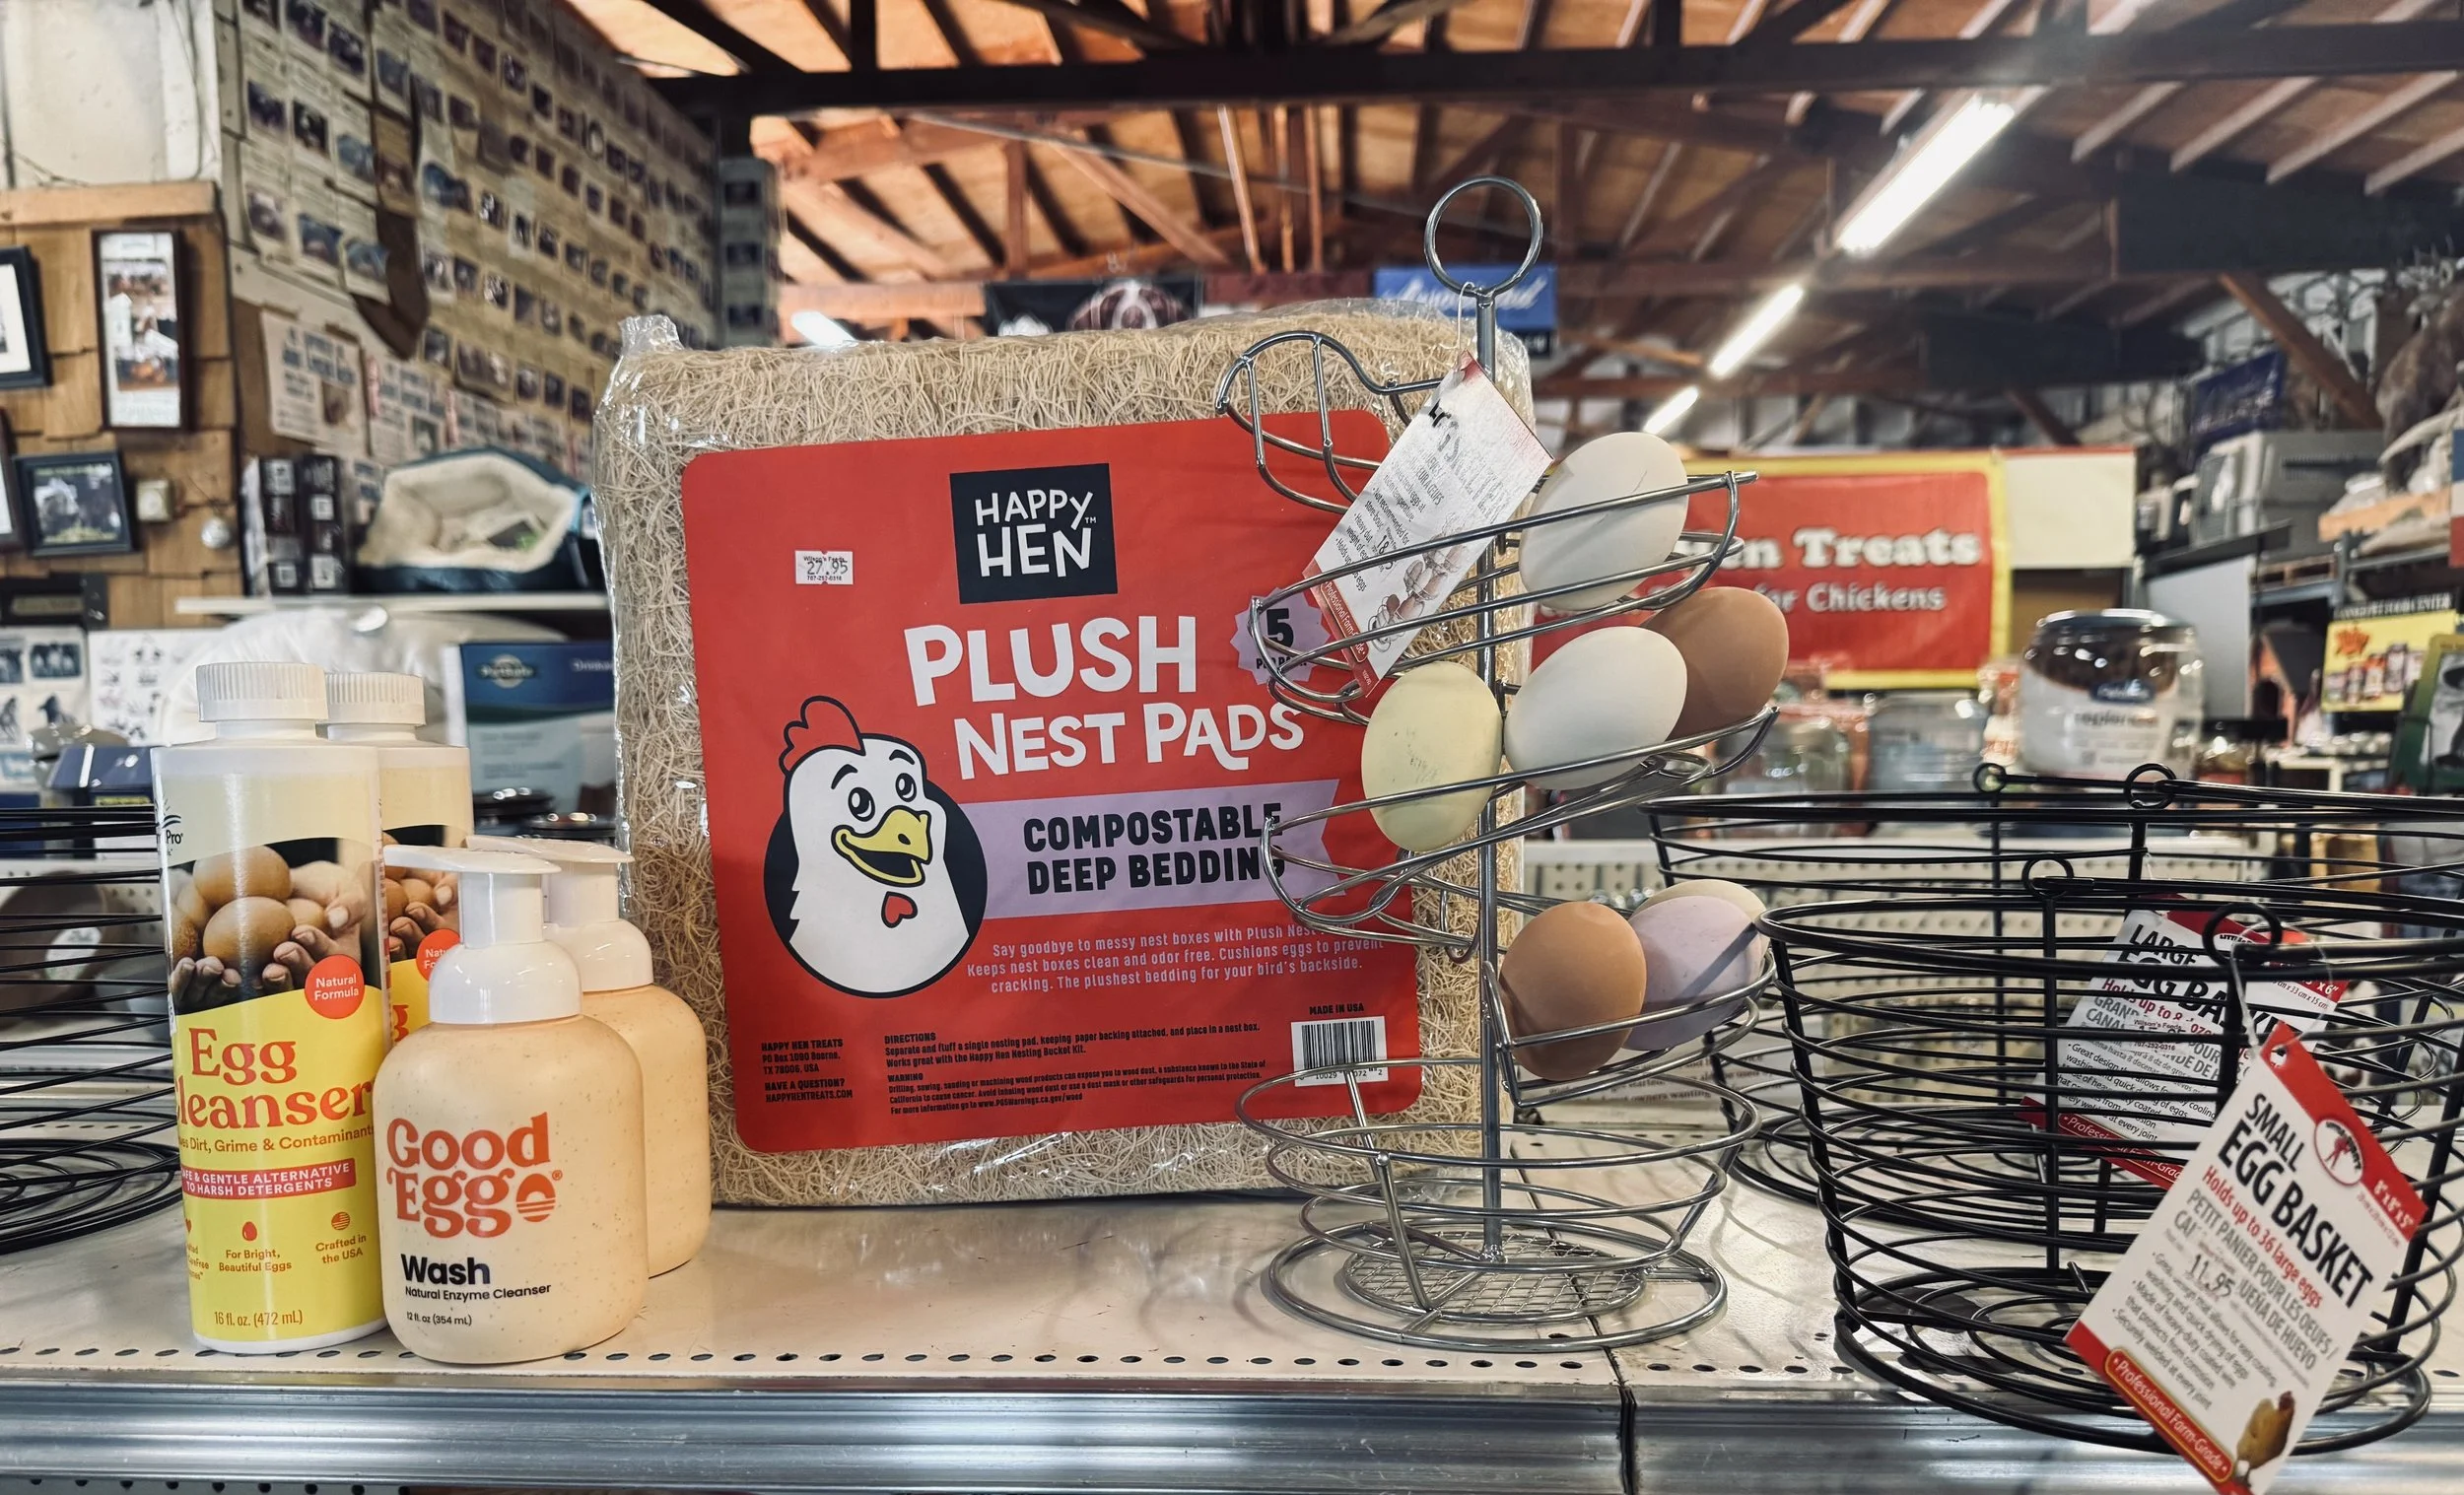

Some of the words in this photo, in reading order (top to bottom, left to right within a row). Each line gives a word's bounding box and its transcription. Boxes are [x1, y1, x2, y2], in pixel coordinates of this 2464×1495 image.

[975, 489, 1093, 530] HAPPY
[1351, 512, 1368, 535] Heavy
[1377, 497, 1405, 538] recommended
[1401, 532, 1410, 547] for
[977, 523, 1091, 578] HEN
[1792, 525, 1983, 569] Treats
[807, 560, 849, 576] 27.95
[1323, 580, 1348, 620] Professional
[1806, 581, 1947, 612] Chickens
[1266, 608, 1294, 648] 5
[904, 616, 1197, 707] PLUSH
[954, 712, 1125, 780] NEST
[1143, 702, 1305, 771] PADS
[1027, 853, 1117, 895] DEEP
[993, 944, 1015, 958] Say
[1021, 939, 1073, 958] goodbye
[1078, 939, 1091, 951] to
[1096, 936, 1135, 952] messy
[1140, 933, 1168, 947] nest
[1173, 932, 1210, 945] boxes
[1213, 928, 1242, 943] with
[1248, 925, 1283, 941] Plush
[968, 963, 1006, 978] Keeps
[1010, 960, 1038, 974] nest
[1043, 957, 1080, 972] boxes
[1084, 954, 1120, 970] clean
[1124, 953, 1147, 968] and
[1151, 951, 1180, 965] odor
[1184, 948, 1215, 964] free.
[1219, 944, 1278, 961] Cushions
[1282, 943, 1313, 958] eggs
[1317, 940, 1330, 953] to
[992, 978, 1054, 993] cracking.
[1057, 976, 1080, 989] The
[1084, 971, 1141, 989] plushest
[1145, 967, 1197, 984] bedding
[1200, 966, 1219, 980] for
[1224, 965, 1253, 981] your
[1257, 961, 1296, 976] bird's
[1300, 957, 1363, 973] backside.
[314, 986, 360, 1001] Formula
[315, 974, 357, 988] Natural
[1309, 1005, 1334, 1015] MADE
[1335, 1004, 1345, 1014] IN
[1346, 1002, 1365, 1013] USA
[761, 1042, 790, 1052] HAPPY
[791, 1041, 809, 1051] HEN
[811, 1039, 844, 1049] TREATS
[884, 1032, 936, 1045] DIRECTIONS
[885, 1045, 921, 1056] Separate
[922, 1044, 936, 1053] and
[938, 1041, 956, 1053] fluff
[964, 1040, 990, 1052] single
[991, 1038, 1020, 1050] nesting
[1040, 1034, 1071, 1046] keeping
[1075, 1032, 1097, 1044] paper
[1099, 1030, 1130, 1041] backing
[1170, 1027, 1185, 1037] and
[1186, 1026, 1207, 1037] place
[1208, 1024, 1217, 1034] in
[1224, 1023, 1243, 1033] nest
[1243, 1022, 1261, 1032] box.
[188, 1027, 298, 1086] Egg
[762, 1053, 773, 1063] PO
[774, 1053, 788, 1063] Box
[789, 1052, 810, 1062] 1090
[763, 1065, 774, 1075] TX
[804, 1063, 820, 1073] USA
[2070, 1042, 2094, 1059] Great
[2090, 1052, 2120, 1073] design
[765, 1082, 787, 1091] HAVE
[789, 1081, 796, 1090] A
[797, 1078, 846, 1090] QUESTION?
[766, 1089, 854, 1103] HAPPYHENTREATS.COM
[177, 1075, 373, 1129] leanser
[190, 1137, 212, 1154] Dirt,
[214, 1138, 258, 1153] Grime
[262, 1139, 275, 1151] &
[386, 1111, 551, 1171] Good
[2115, 1117, 2140, 1135] every
[2137, 1127, 2158, 1143] joint
[2242, 1089, 2310, 1174] SMALL
[186, 1182, 196, 1192] TO
[197, 1184, 234, 1196] HARSH
[238, 1178, 333, 1196] DETERGENTS
[194, 1172, 200, 1183] &
[202, 1173, 248, 1185] GENTLE
[252, 1162, 350, 1184] ALTERNATIVE
[386, 1167, 515, 1239] Egg
[2216, 1118, 2287, 1208] EGG
[2268, 1179, 2376, 1312] BASKET
[226, 1250, 241, 1259] For
[243, 1249, 281, 1260] Bright,
[315, 1234, 356, 1253] Crafted
[358, 1234, 367, 1245] in
[322, 1254, 340, 1264] the
[342, 1247, 364, 1260] USA
[2201, 1164, 2237, 1209] Holds
[2227, 1199, 2250, 1229] up
[2246, 1216, 2263, 1240] to
[2257, 1228, 2277, 1255] 36
[2268, 1243, 2302, 1287] large
[2293, 1275, 2323, 1314] eggs
[219, 1261, 262, 1273] Beautiful
[264, 1261, 293, 1273] Eggs
[400, 1253, 491, 1286] Wash
[2185, 1185, 2224, 1232] PETIT
[2215, 1218, 2259, 1273] PANIER
[2252, 1260, 2289, 1307] POUR
[2280, 1291, 2304, 1324] LES
[2295, 1309, 2333, 1356] OEUFS
[2187, 1247, 2235, 1308] 11.95
[405, 1286, 442, 1301] Natural
[443, 1289, 491, 1304] Enzyme
[493, 1283, 552, 1300] Cleanser
[214, 1311, 225, 1325] 16
[226, 1312, 236, 1327] fl.
[237, 1315, 251, 1326] oz.
[253, 1312, 279, 1328] (472
[282, 1309, 304, 1325] mL)
[406, 1311, 414, 1321] 12
[421, 1315, 431, 1325] oz
[432, 1314, 453, 1325] (354
[454, 1314, 472, 1326] mL)
[2265, 1309, 2287, 1337] DE
[2278, 1324, 2318, 1374] HUEVO
[2115, 1353, 2174, 1425] Professional
[2169, 1409, 2224, 1475] Farm-Grade
